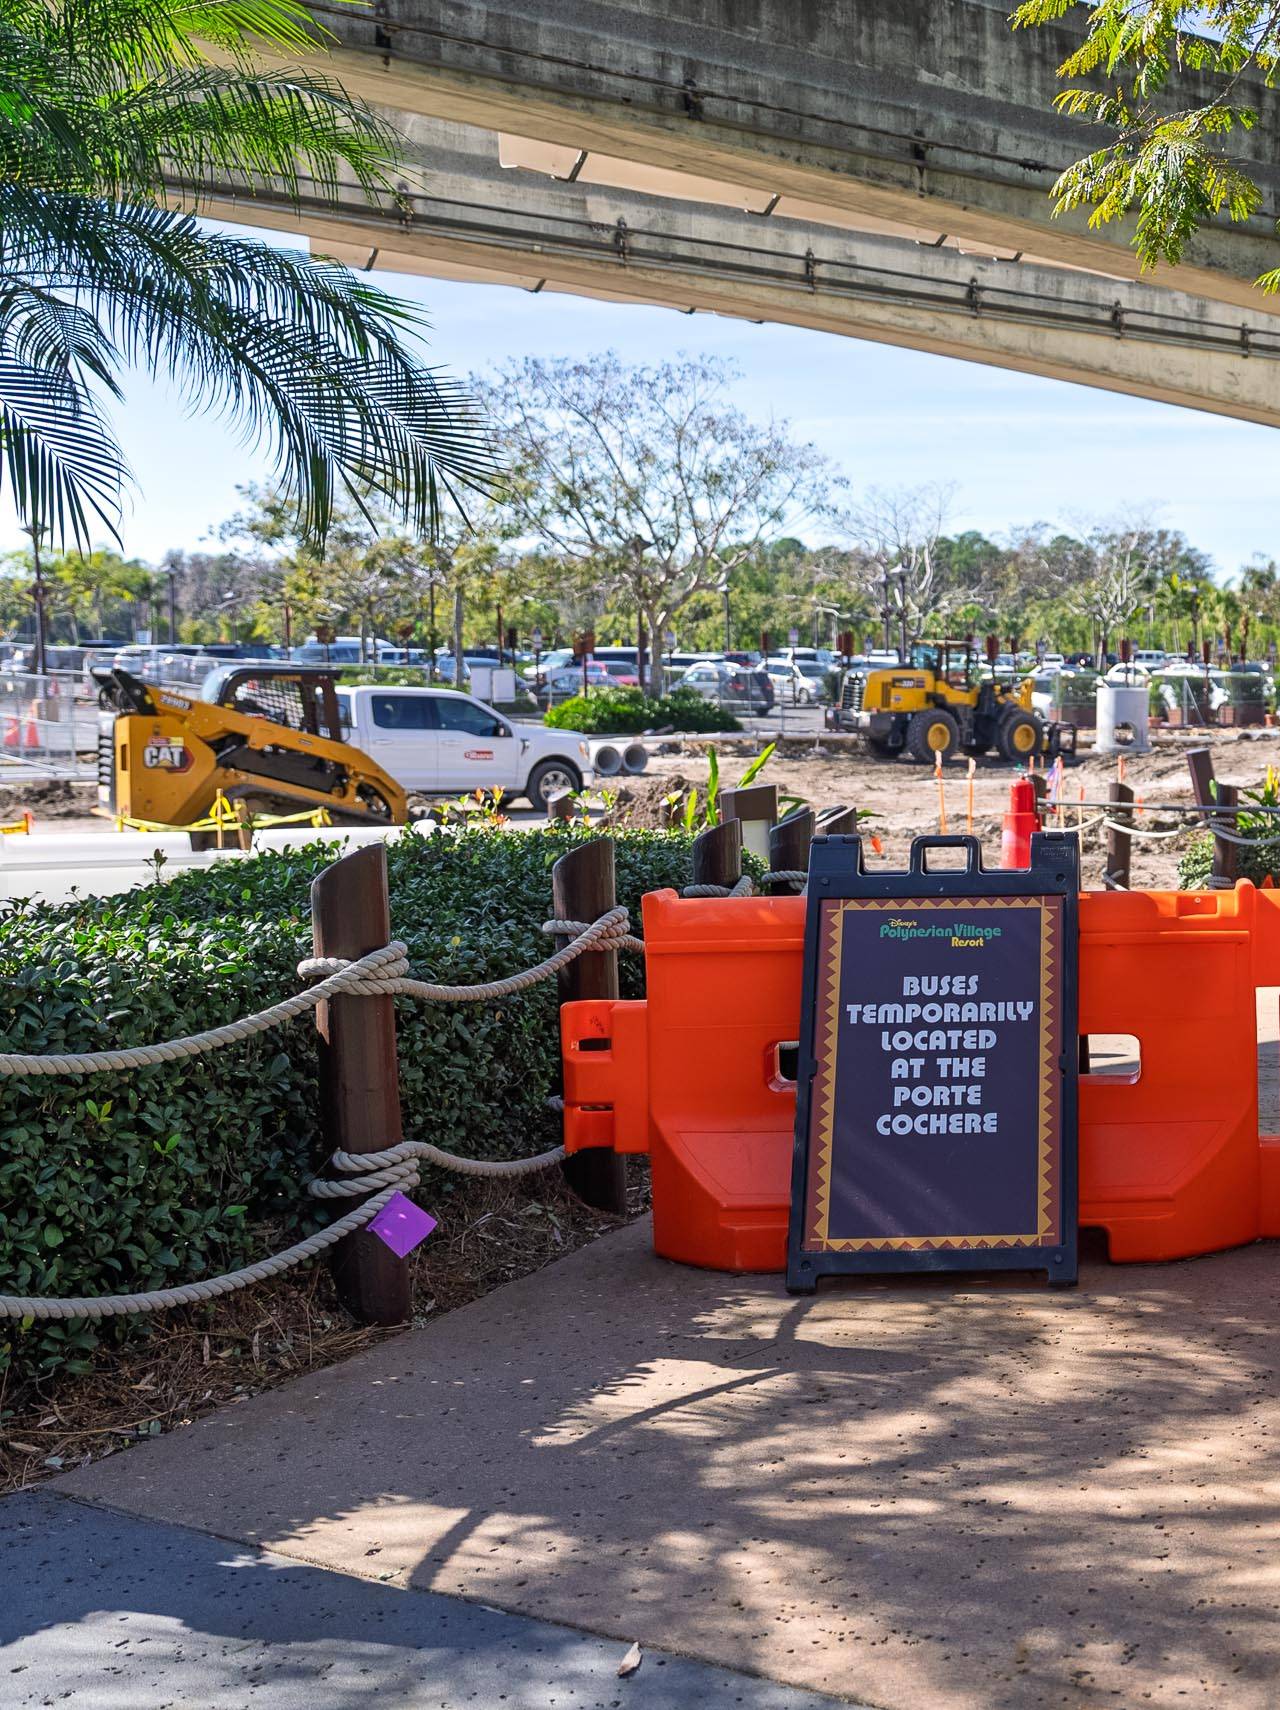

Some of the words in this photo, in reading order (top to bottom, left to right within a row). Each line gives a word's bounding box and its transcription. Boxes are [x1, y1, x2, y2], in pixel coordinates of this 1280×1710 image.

[144, 746, 183, 768] CAT
[880, 924, 953, 941] Polynesian
[954, 923, 1002, 940] Village
[888, 918, 917, 928] Disney's
[951, 936, 984, 947] Resort
[902, 975, 979, 997] BUSES
[846, 1001, 1034, 1025] TEMPORARILY
[881, 1029, 998, 1051] LOCATED
[890, 1058, 925, 1079] AT
[935, 1057, 986, 1078] THE
[893, 1085, 982, 1107] PORTE
[876, 1112, 998, 1136] COCHERE
